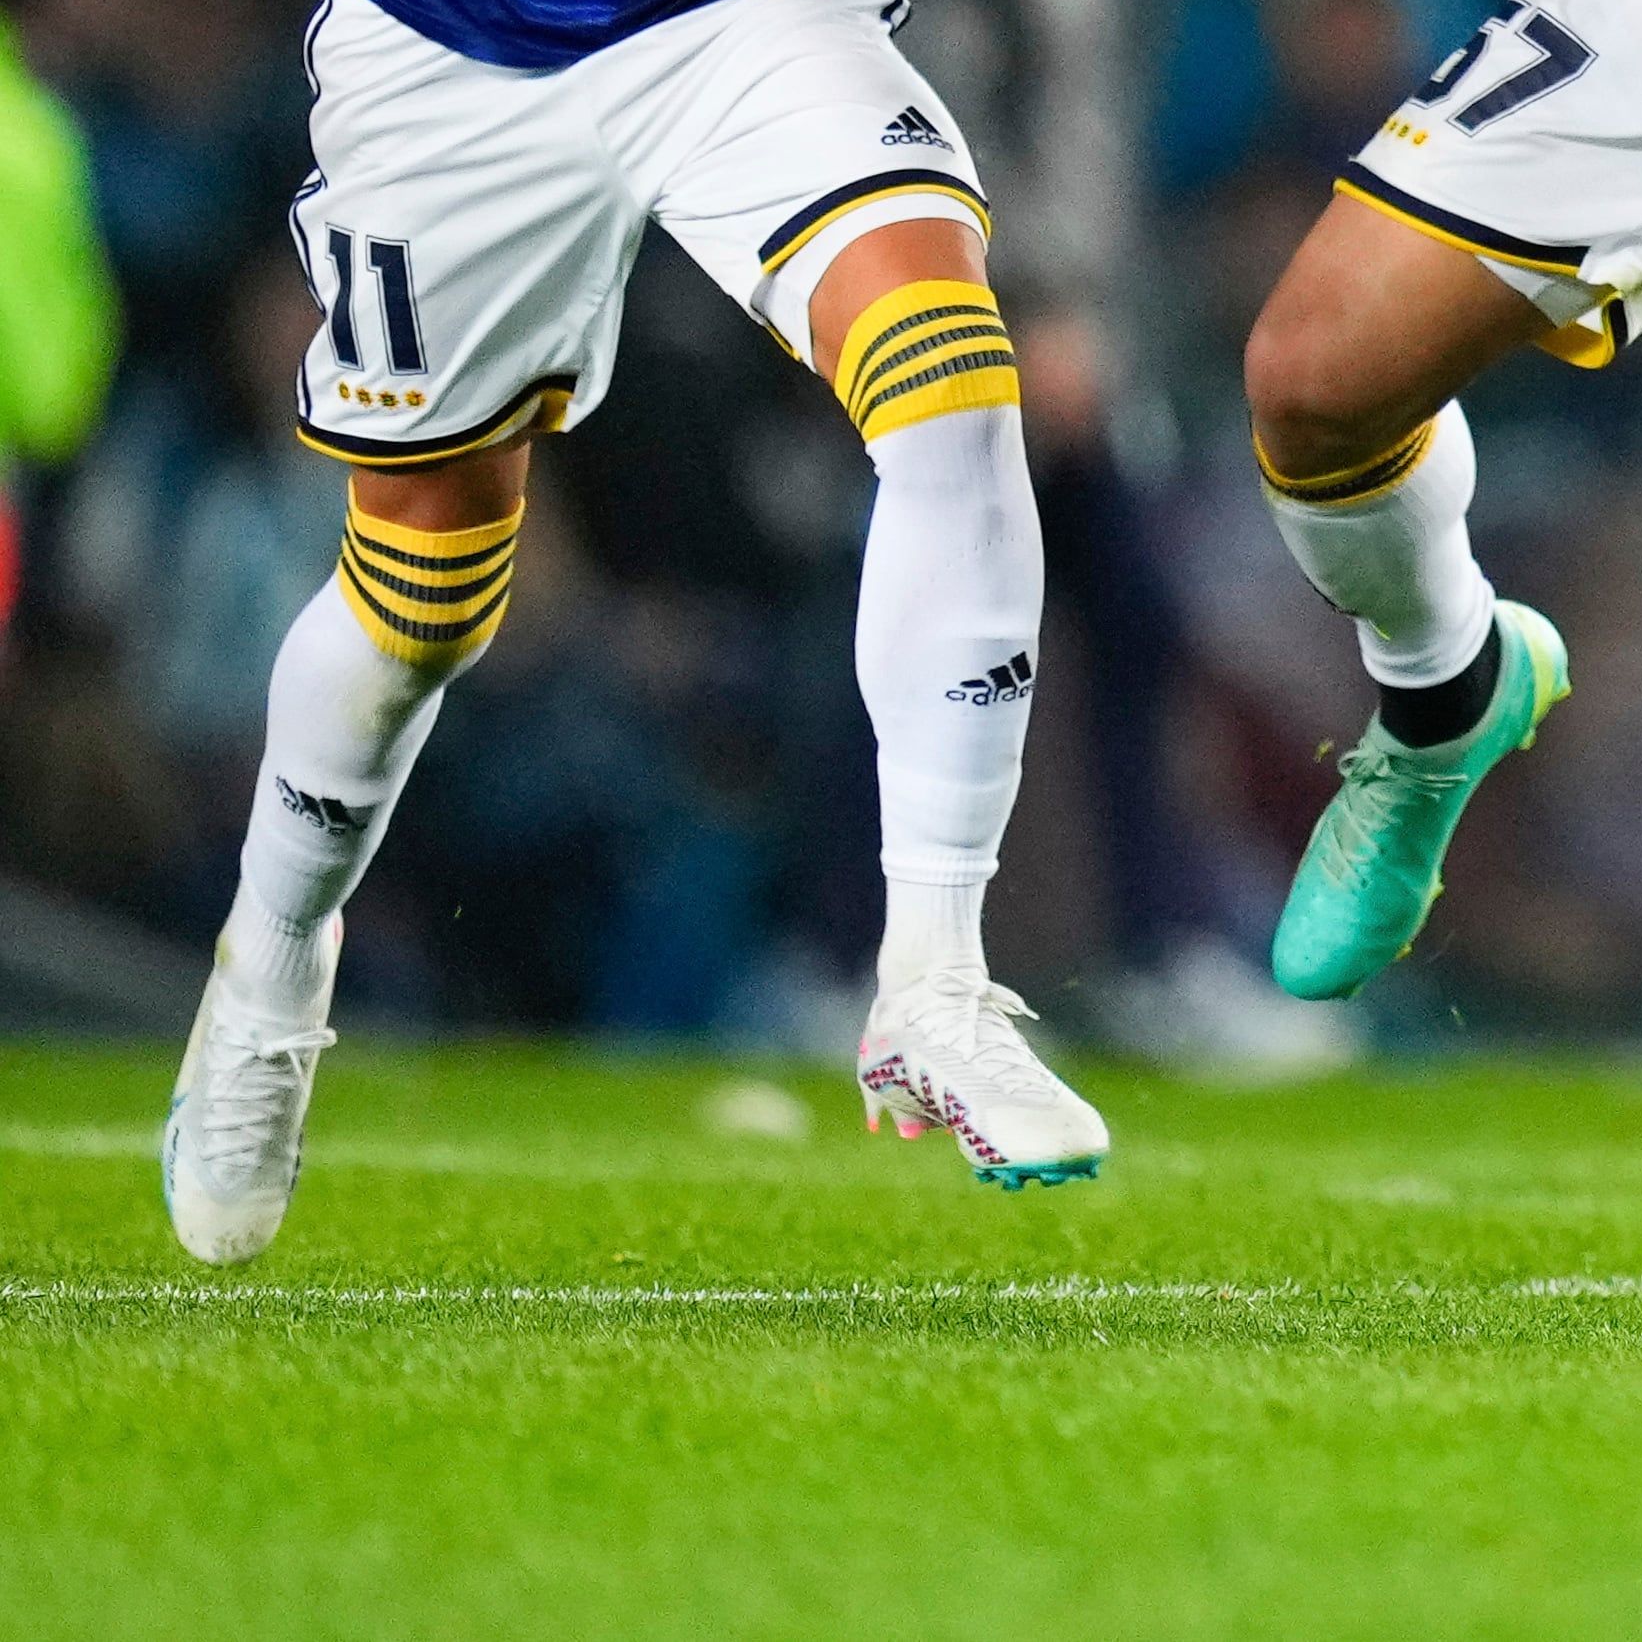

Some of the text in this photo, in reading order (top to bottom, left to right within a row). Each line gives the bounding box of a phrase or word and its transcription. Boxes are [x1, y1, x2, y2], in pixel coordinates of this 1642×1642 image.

[880, 128, 956, 154] adidas
[321, 221, 424, 376] 11
[946, 683, 1034, 706] adida
